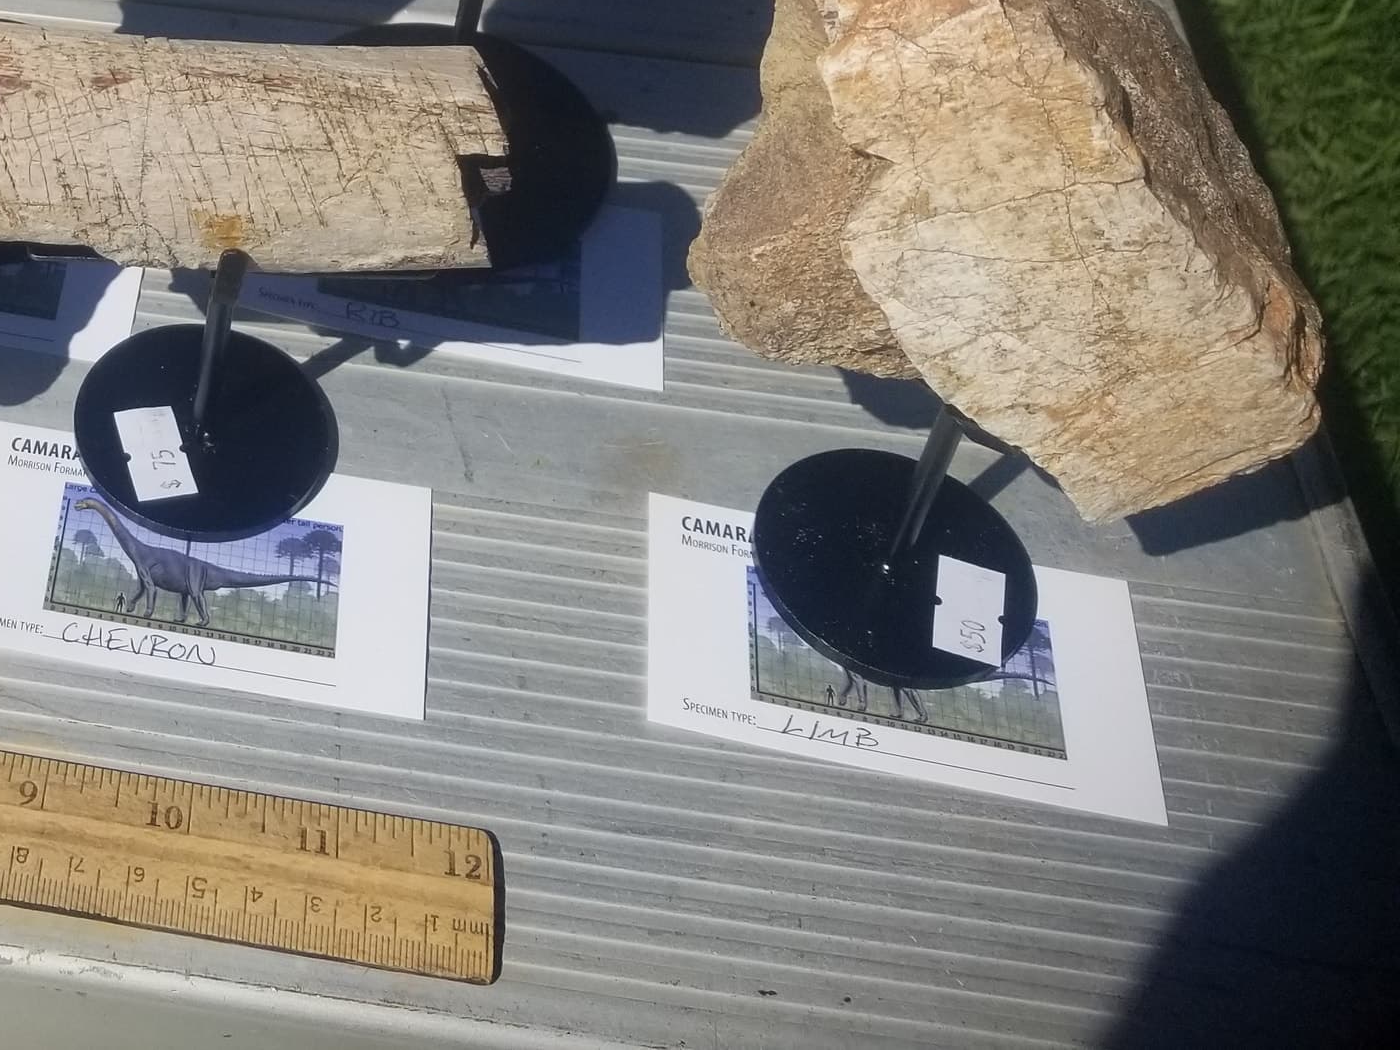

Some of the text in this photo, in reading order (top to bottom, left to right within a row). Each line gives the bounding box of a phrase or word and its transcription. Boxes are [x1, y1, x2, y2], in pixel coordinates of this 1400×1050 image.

[7, 455, 52, 472] MORRISON
[681, 534, 729, 554] MORRISON
[19, 620, 44, 635] TYPE:
[959, 619, 985, 654] $50
[62, 622, 217, 665] CHEVRON
[682, 697, 757, 728] SPECIMEN TYPE:
[780, 714, 879, 749] LIMB
[19, 780, 38, 806] 9
[145, 801, 184, 830] 10
[295, 827, 331, 856] 11
[443, 850, 484, 880] 12
[15, 846, 30, 864] 8
[72, 856, 86, 874] 7
[133, 866, 146, 883] 6
[191, 876, 209, 899] 5
[249, 886, 264, 903] 4
[310, 896, 324, 913] 3
[370, 905, 383, 923] 2
[428, 914, 440, 932] 1
[452, 917, 490, 936] mm
